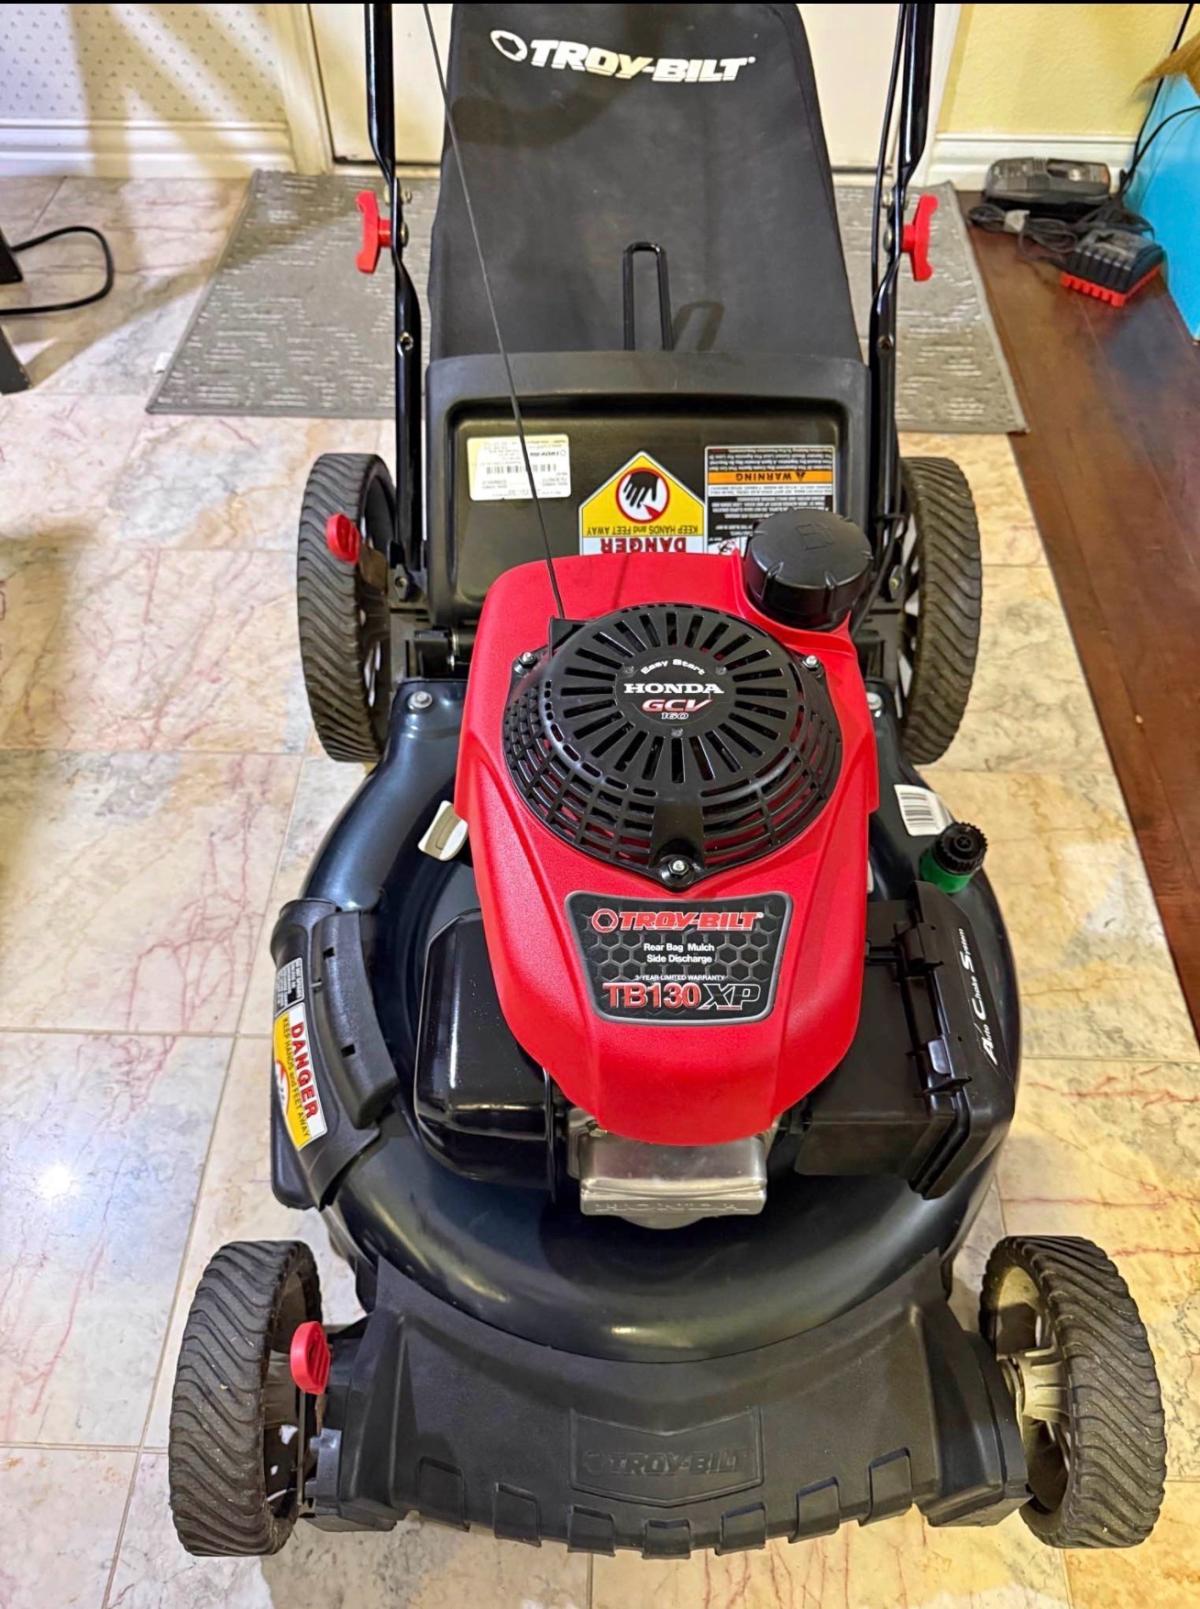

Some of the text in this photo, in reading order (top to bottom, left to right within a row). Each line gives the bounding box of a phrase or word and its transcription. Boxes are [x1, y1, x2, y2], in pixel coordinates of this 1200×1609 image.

[735, 473, 792, 481] WARNING
[587, 526, 609, 536] AWAY
[612, 526, 631, 535] FEET
[649, 525, 675, 535] HANDS
[678, 525, 698, 533] KEEP
[600, 538, 687, 553] DANGER
[640, 659, 705, 675] Easy Start
[624, 683, 724, 694] HONDA
[641, 699, 713, 712] GCV
[643, 943, 715, 953] Rear Bag Mulch
[646, 954, 712, 964] Side Discharge
[959, 928, 998, 1066] Auto Choke System
[291, 1022, 319, 1120] DANGER
[291, 1084, 302, 1109] FEET
[297, 1110, 311, 1137] AWAY
